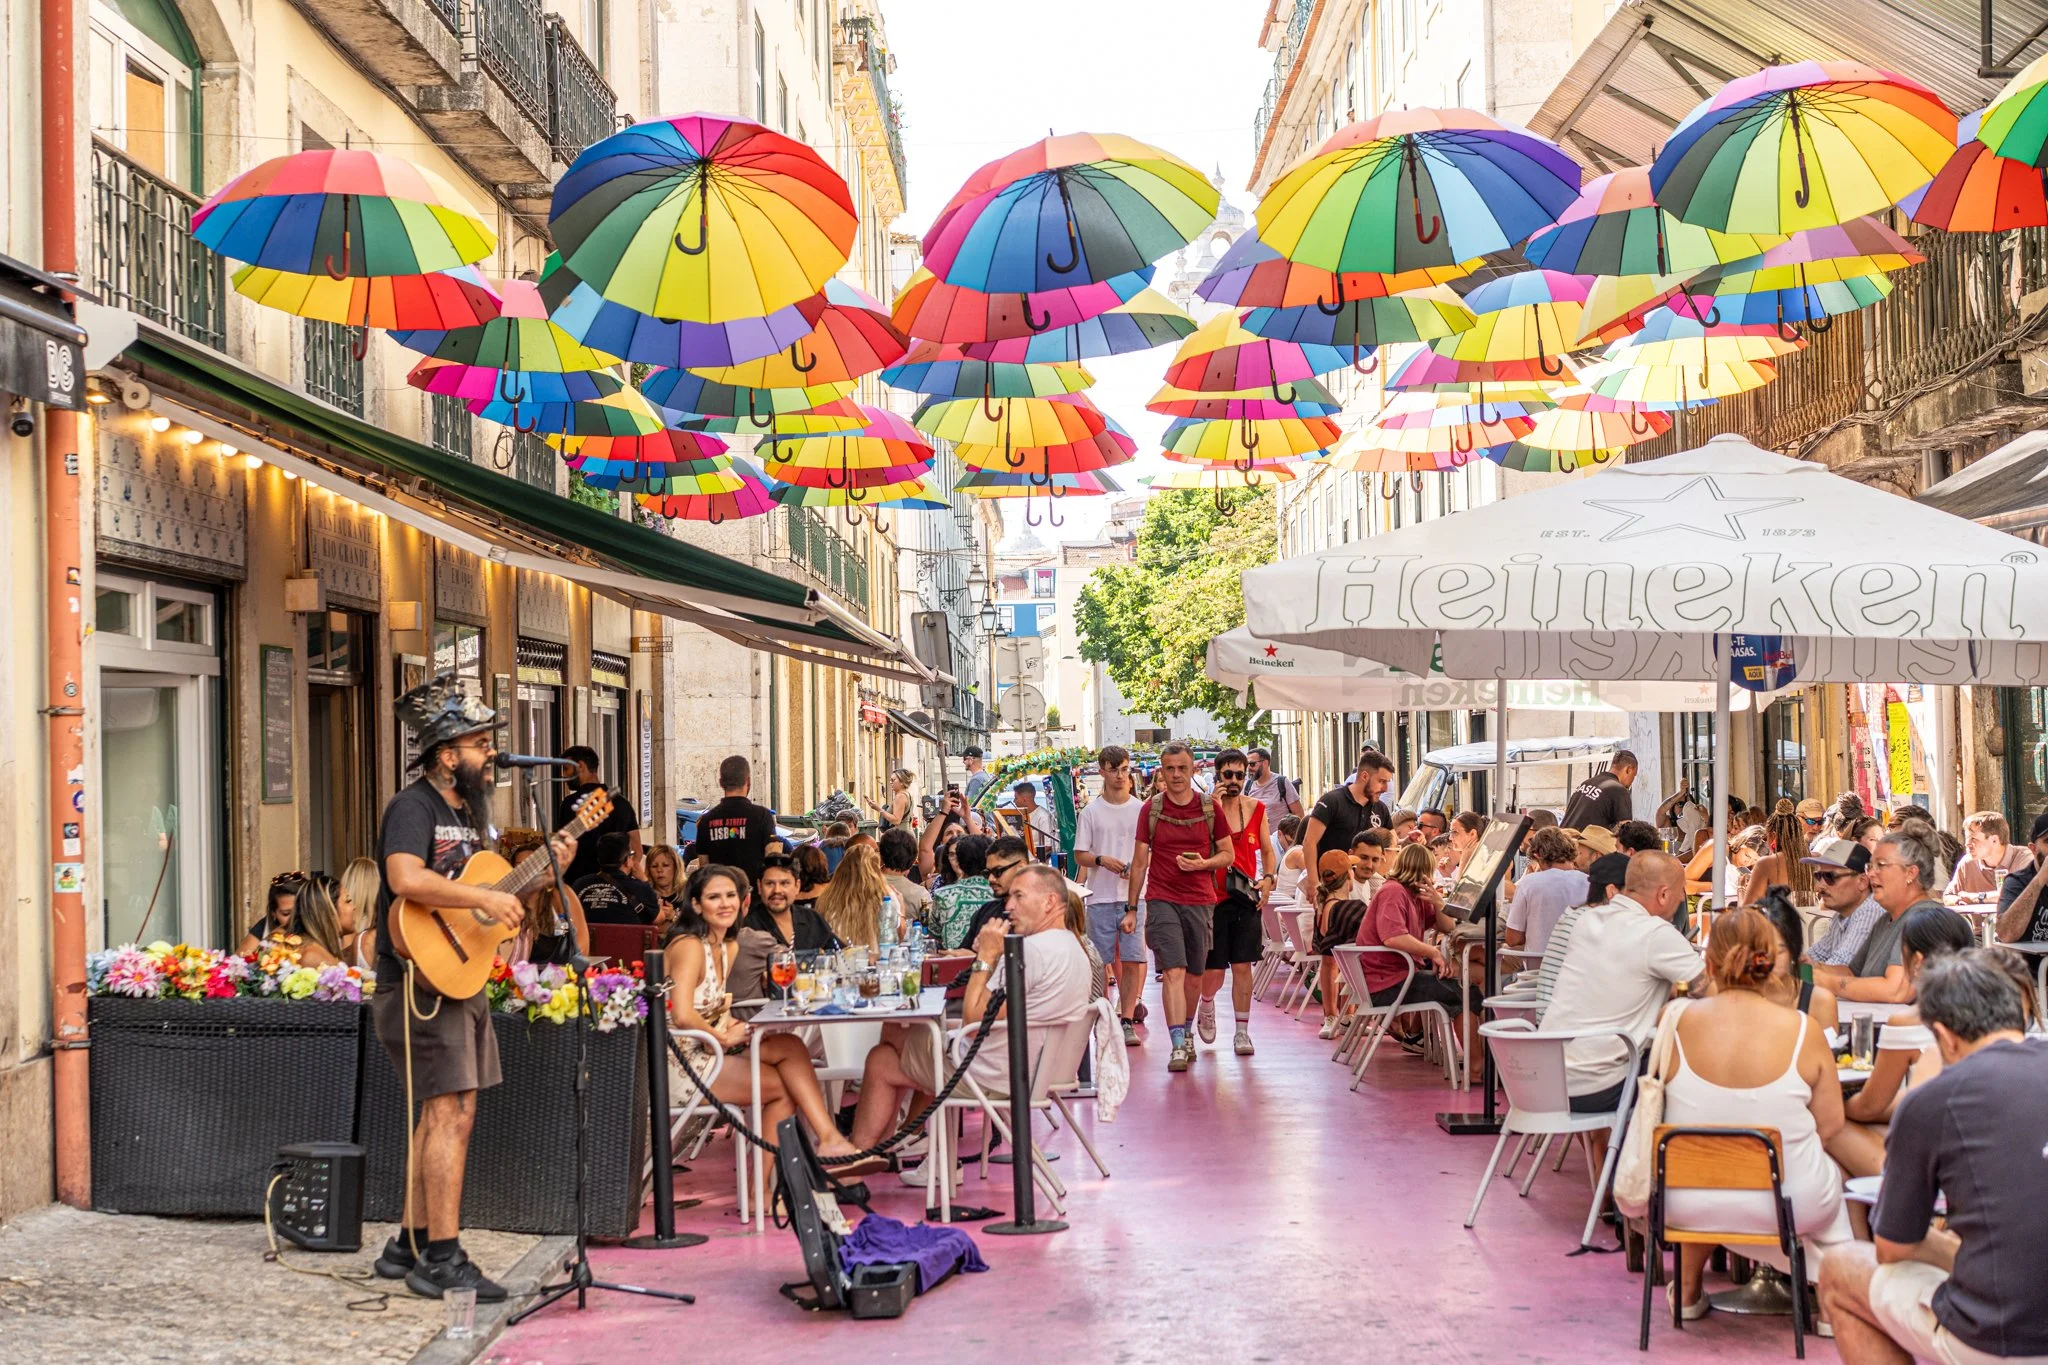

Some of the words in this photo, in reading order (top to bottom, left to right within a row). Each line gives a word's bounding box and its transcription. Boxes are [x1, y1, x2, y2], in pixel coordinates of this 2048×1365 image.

[1539, 529, 1591, 539] EST.
[1760, 528, 1817, 538] 1873
[338, 542, 369, 569] GRANDE
[1249, 656, 1294, 668] Heineken
[725, 817, 748, 827] STREET
